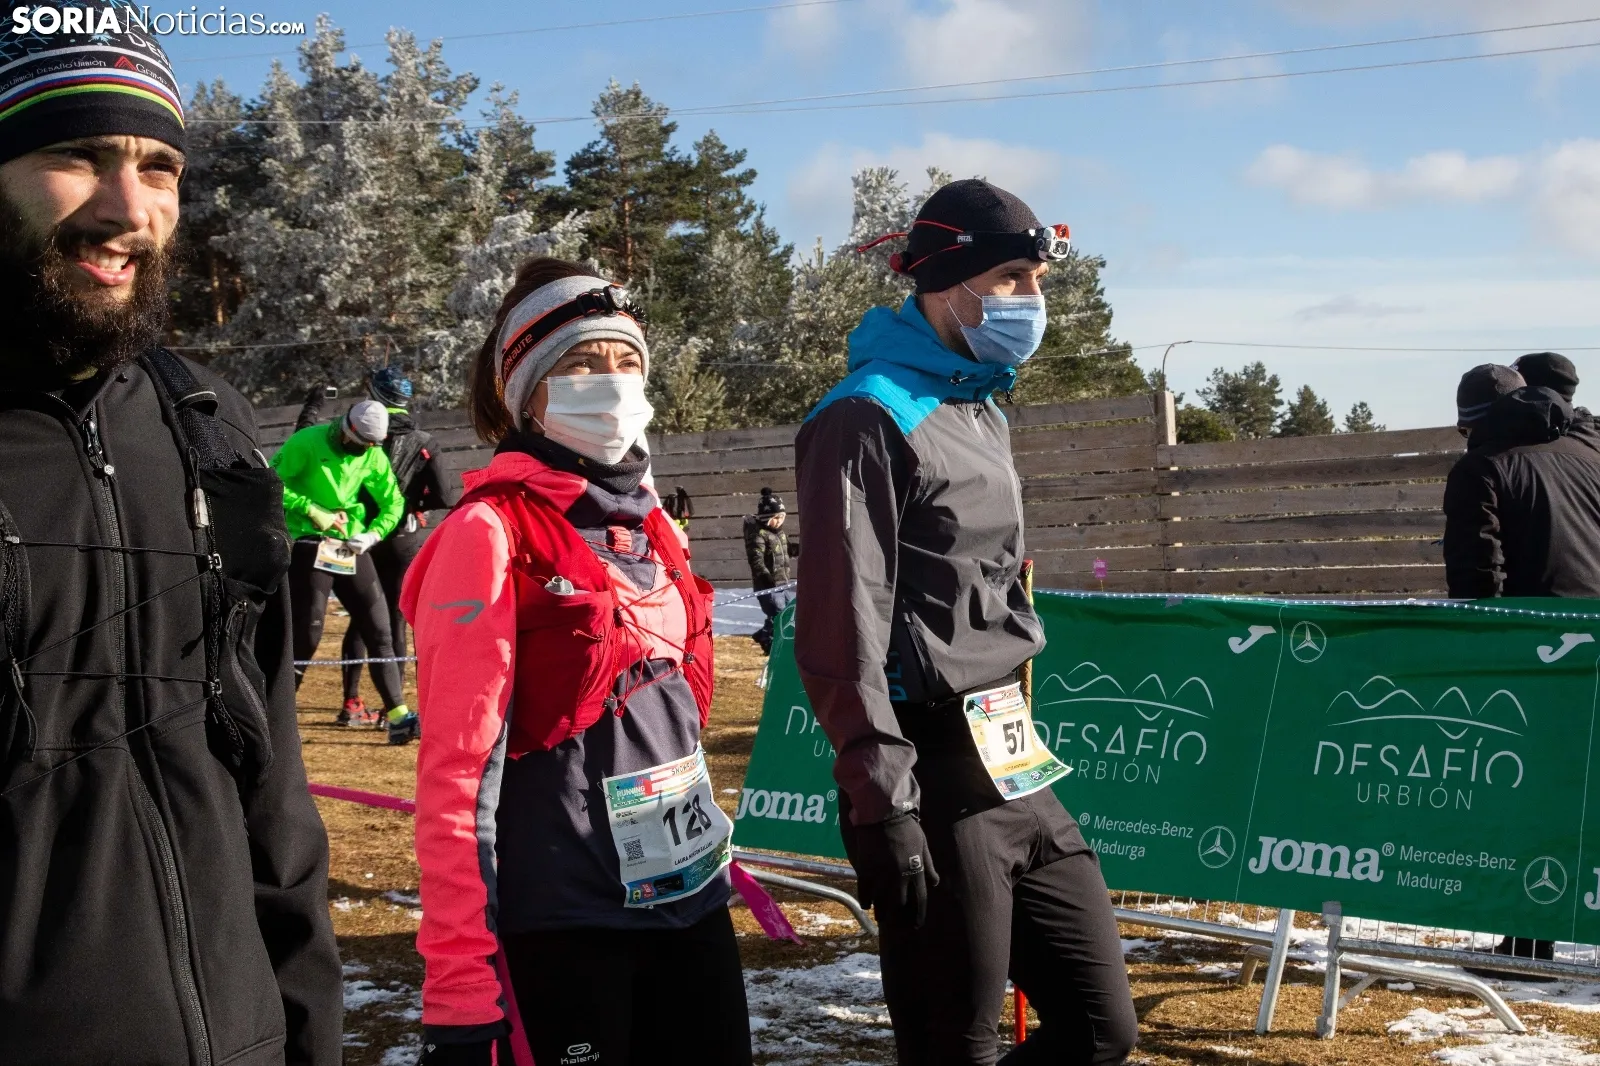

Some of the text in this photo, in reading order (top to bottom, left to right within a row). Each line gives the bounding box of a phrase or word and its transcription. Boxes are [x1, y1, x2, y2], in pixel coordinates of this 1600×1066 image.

[1003, 719, 1025, 755] 57
[1314, 737, 1524, 788] DESAFÍO
[1357, 782, 1472, 810] URBIÓN
[663, 794, 712, 846] 128
[1093, 815, 1194, 839] Mercedes-Benz
[1089, 838, 1146, 861] Madurga
[1400, 845, 1516, 871] Mercedes-Benz
[1396, 870, 1462, 895] Madurga
